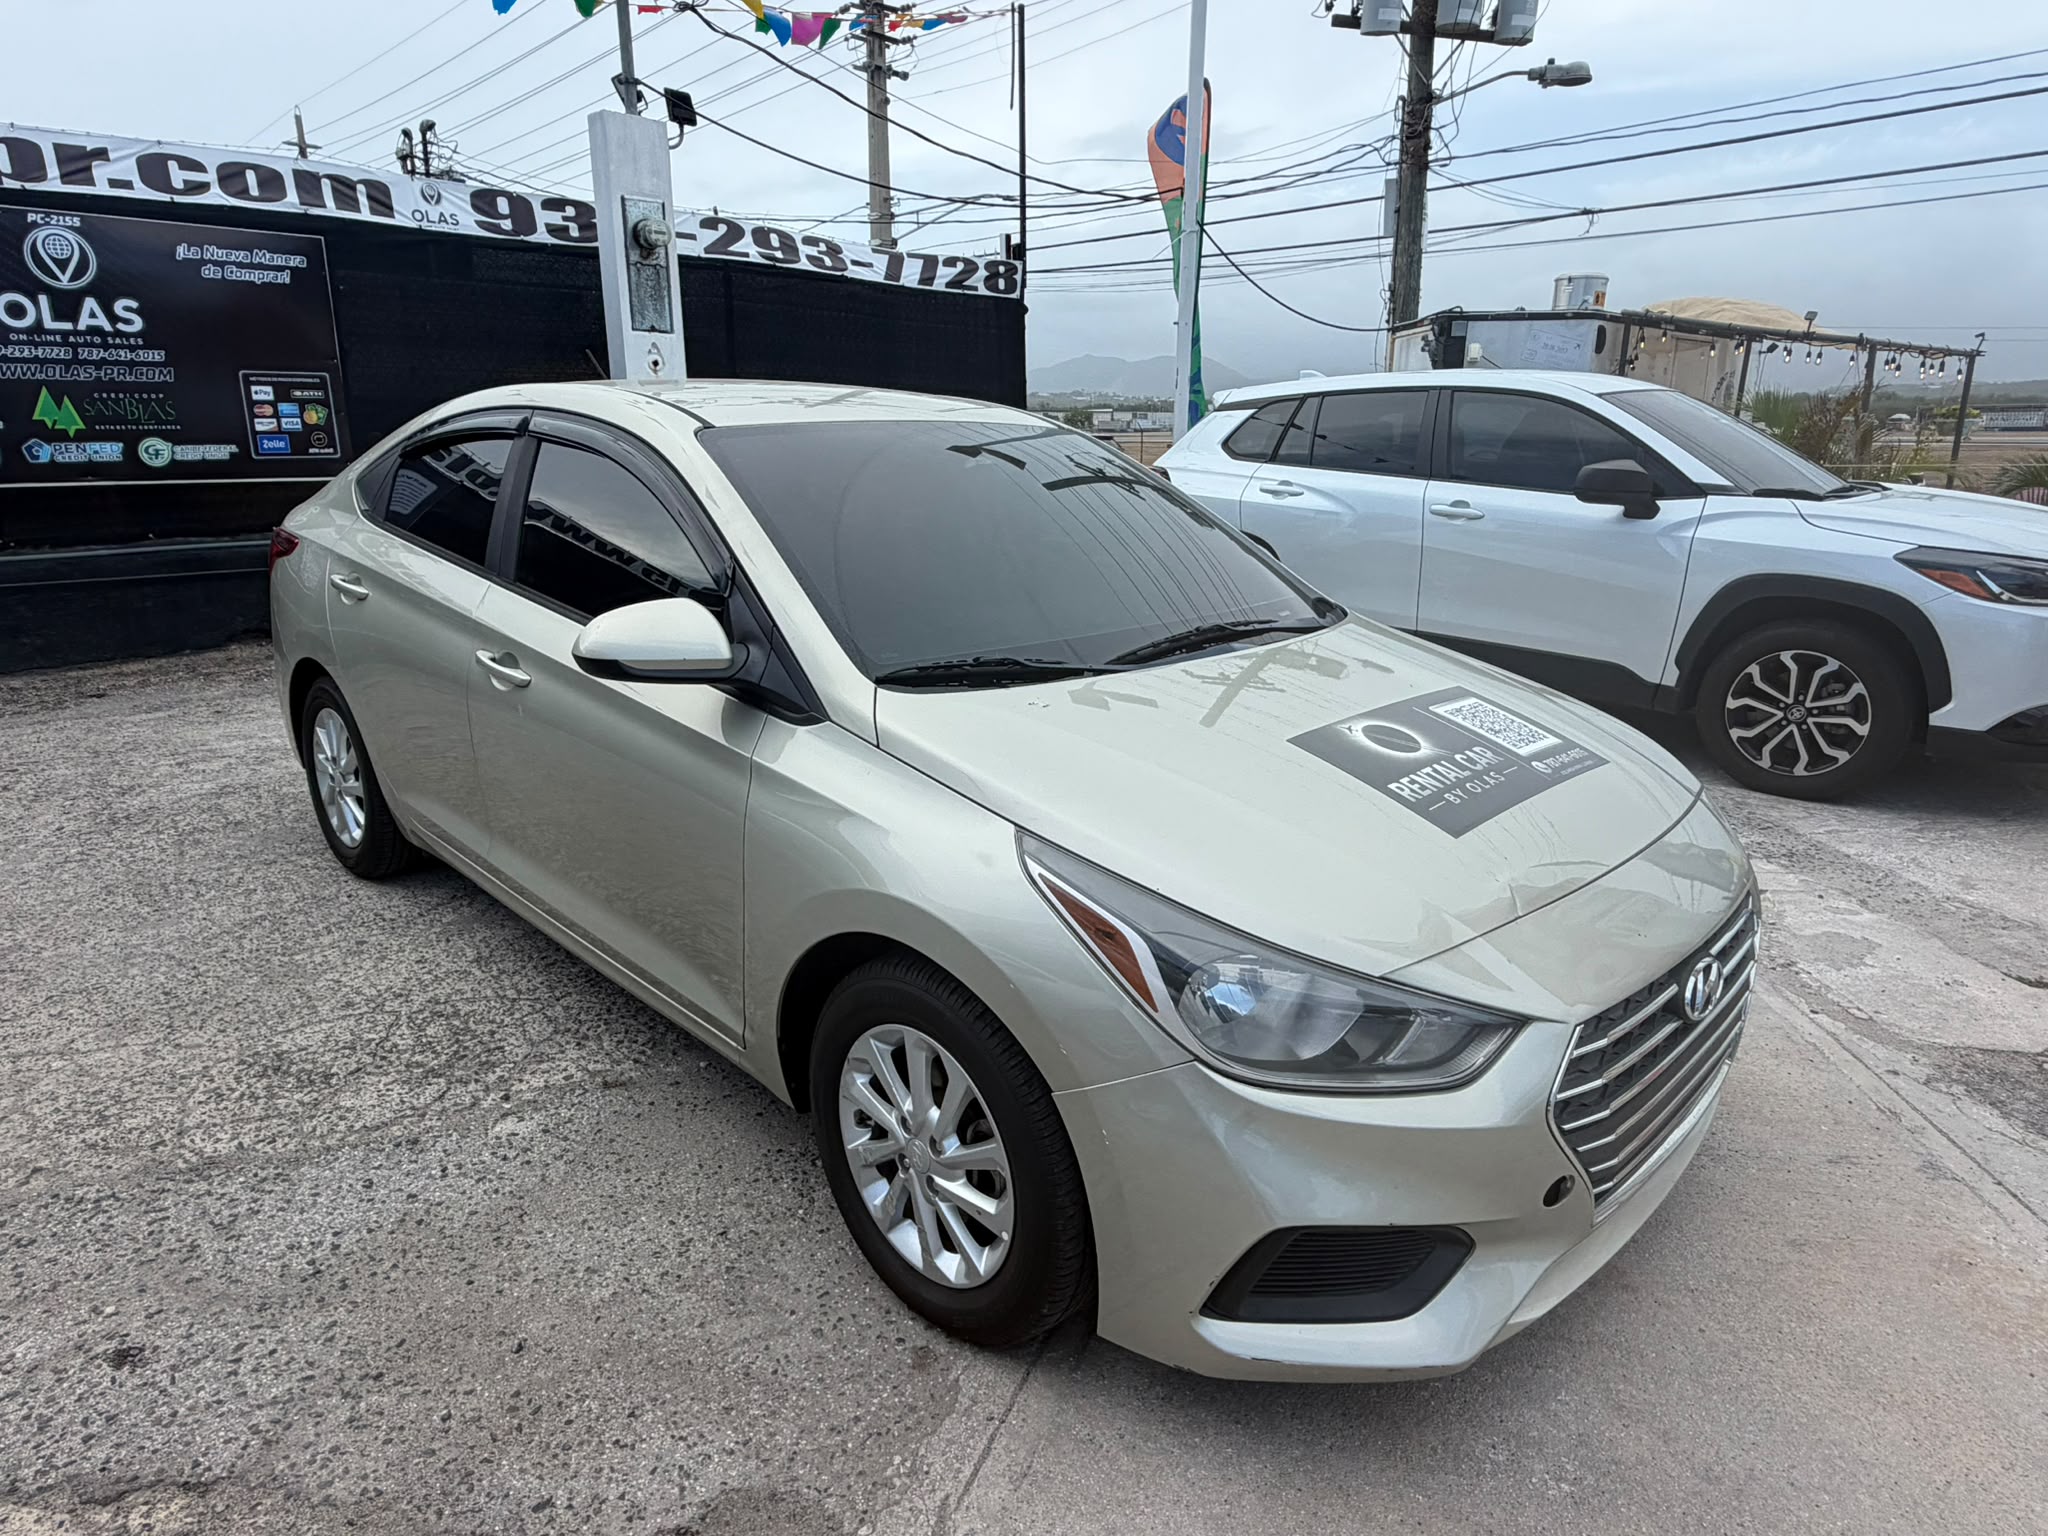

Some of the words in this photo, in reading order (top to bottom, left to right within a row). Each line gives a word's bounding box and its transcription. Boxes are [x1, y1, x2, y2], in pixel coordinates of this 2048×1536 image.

[27, 213, 81, 227] PC-2155
[411, 209, 460, 226] OLAS
[176, 243, 201, 260] ¡La
[203, 245, 251, 263] Nueva
[252, 249, 307, 268] Manera
[201, 264, 222, 279] de
[224, 265, 291, 284] Comprar!
[0, 292, 144, 333] OLAS
[9, 333, 62, 343] ON-LINE
[68, 335, 102, 344] AUTO
[107, 337, 144, 346] SALES
[78, 347, 166, 362] 787-641-6015
[52, 442, 122, 455] PENFED
[1387, 760, 1472, 802] RENTAL
[1454, 746, 1504, 771] CAR
[1443, 788, 1469, 804] BY
[1465, 771, 1505, 793] OLAS
